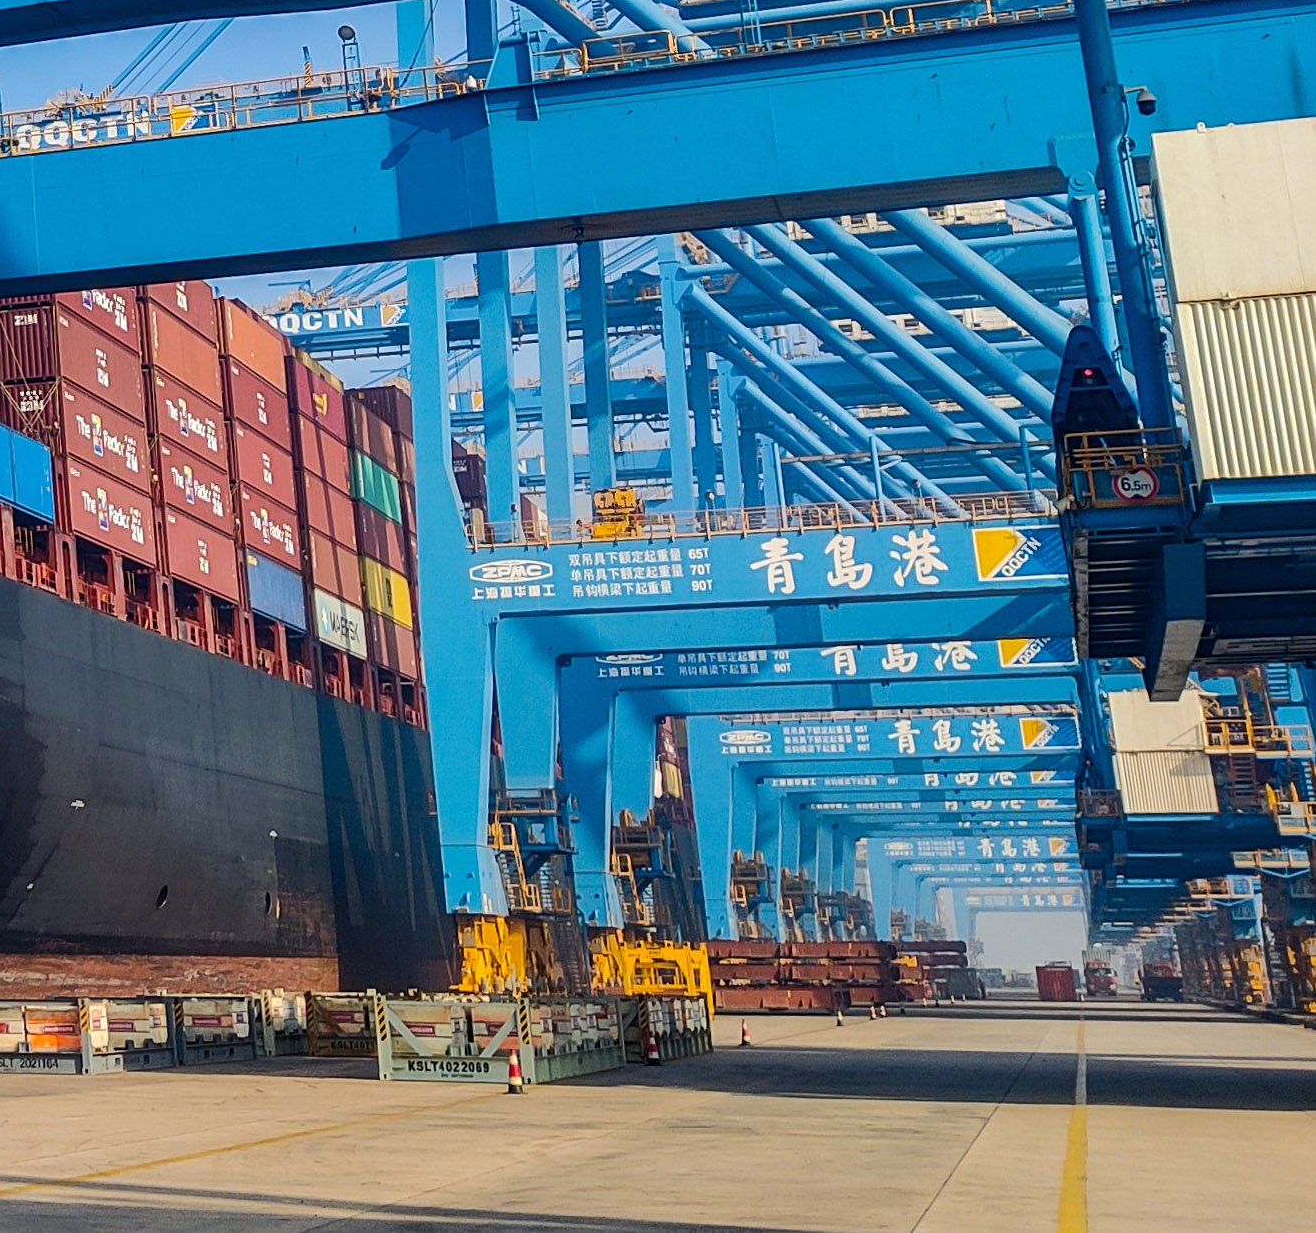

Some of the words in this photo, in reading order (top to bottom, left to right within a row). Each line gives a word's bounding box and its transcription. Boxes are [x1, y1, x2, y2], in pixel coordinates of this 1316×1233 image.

[1120, 477, 1152, 491] 6.5m
[688, 547, 710, 560] 65T
[1002, 536, 1042, 577] QQCTN
[481, 565, 543, 579] ZPMC
[690, 563, 712, 575] 70T
[691, 579, 713, 591] 90T
